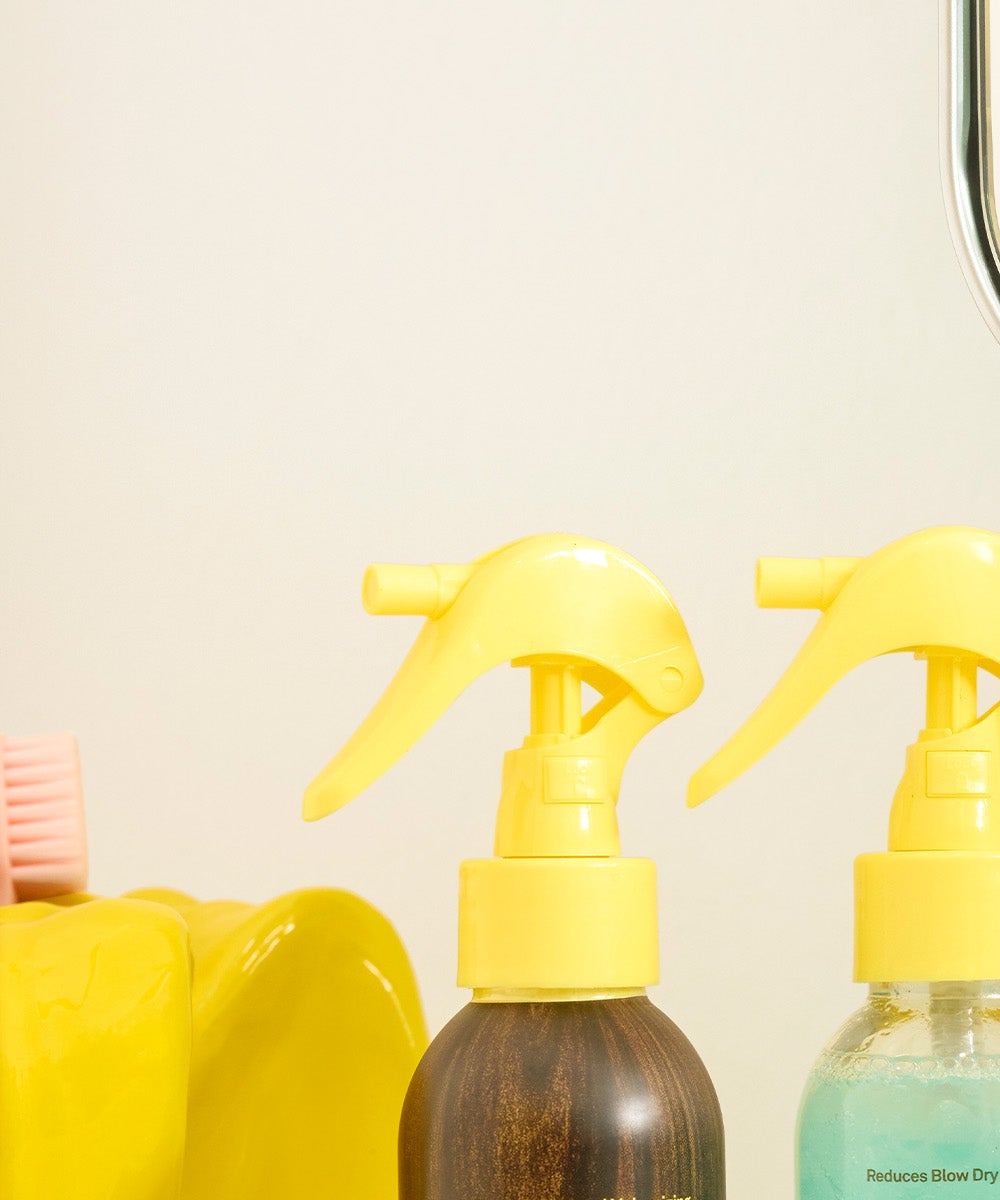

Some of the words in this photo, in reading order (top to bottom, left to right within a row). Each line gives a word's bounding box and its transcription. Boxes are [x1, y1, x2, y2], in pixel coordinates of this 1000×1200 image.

[867, 1169, 927, 1182] Reduces
[932, 1169, 968, 1182] Blow
[973, 1169, 998, 1184] Dry
